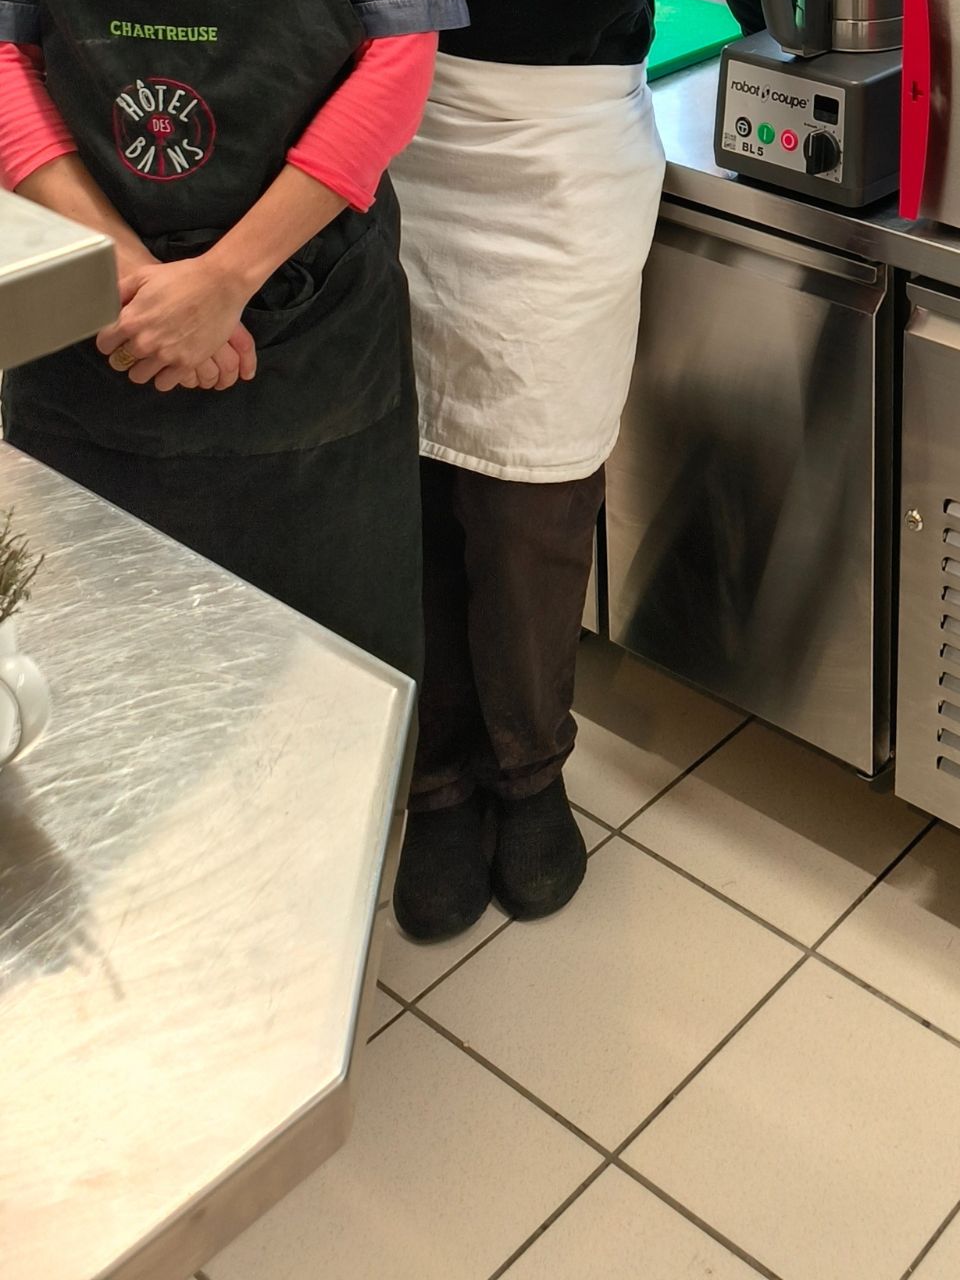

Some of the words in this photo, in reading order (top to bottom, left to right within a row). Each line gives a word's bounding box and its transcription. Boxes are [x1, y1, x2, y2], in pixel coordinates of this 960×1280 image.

[110, 20, 218, 41] CHARTREUSE
[730, 80, 761, 97] robot
[771, 90, 809, 109] coupe
[152, 119, 171, 133] DES
